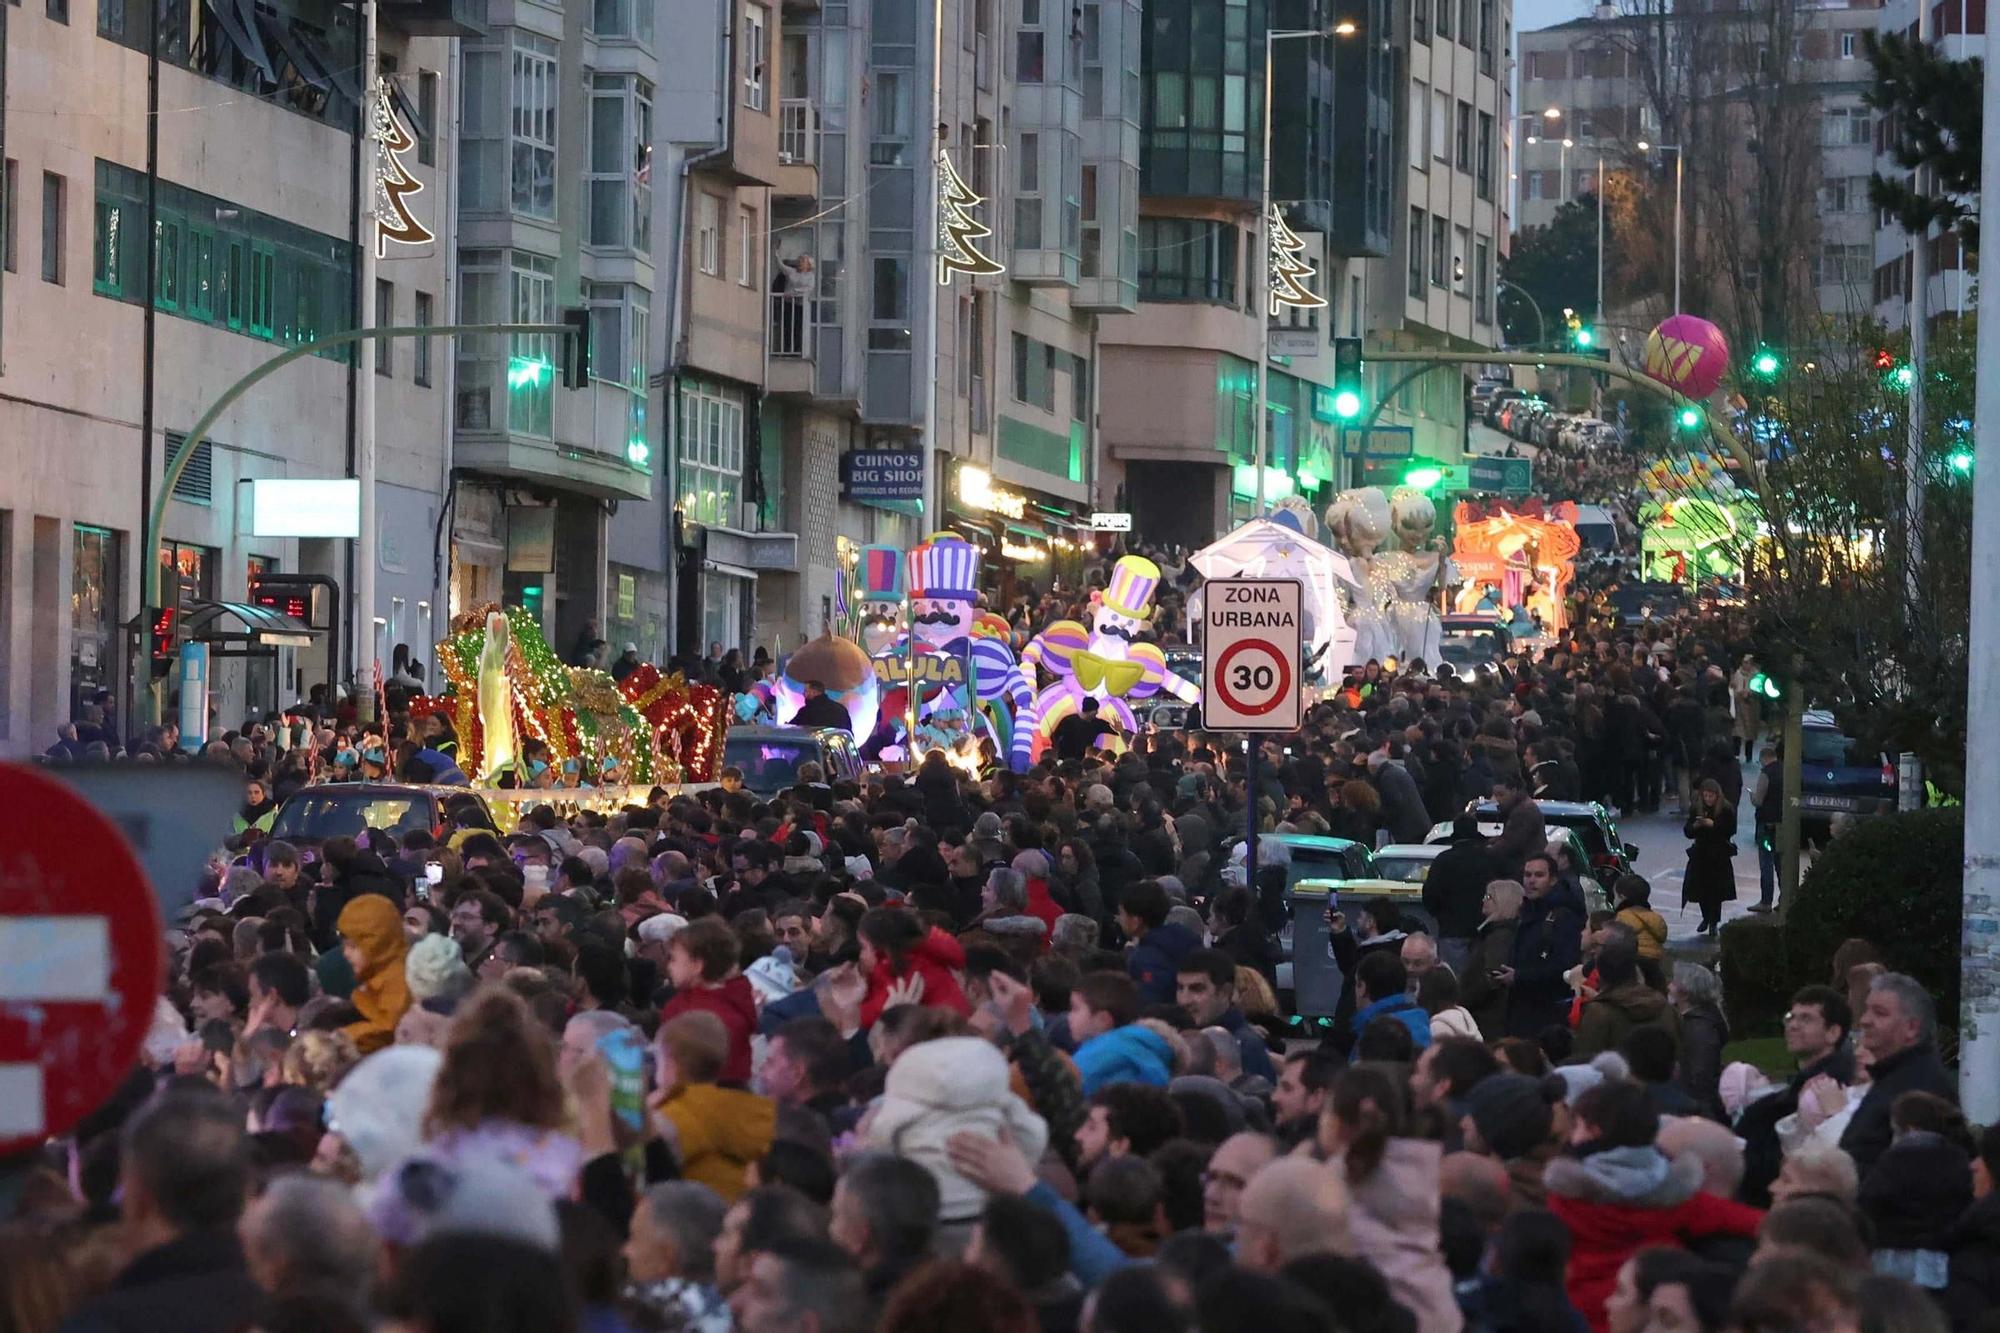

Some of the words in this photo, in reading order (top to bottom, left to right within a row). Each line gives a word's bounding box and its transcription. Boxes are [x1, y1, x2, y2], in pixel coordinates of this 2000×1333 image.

[855, 455, 919, 467] CHINO'S
[851, 470, 879, 482] BIG
[1225, 587, 1281, 603] ZONA
[1212, 611, 1294, 627] URBANA
[1232, 665, 1274, 691] 30
